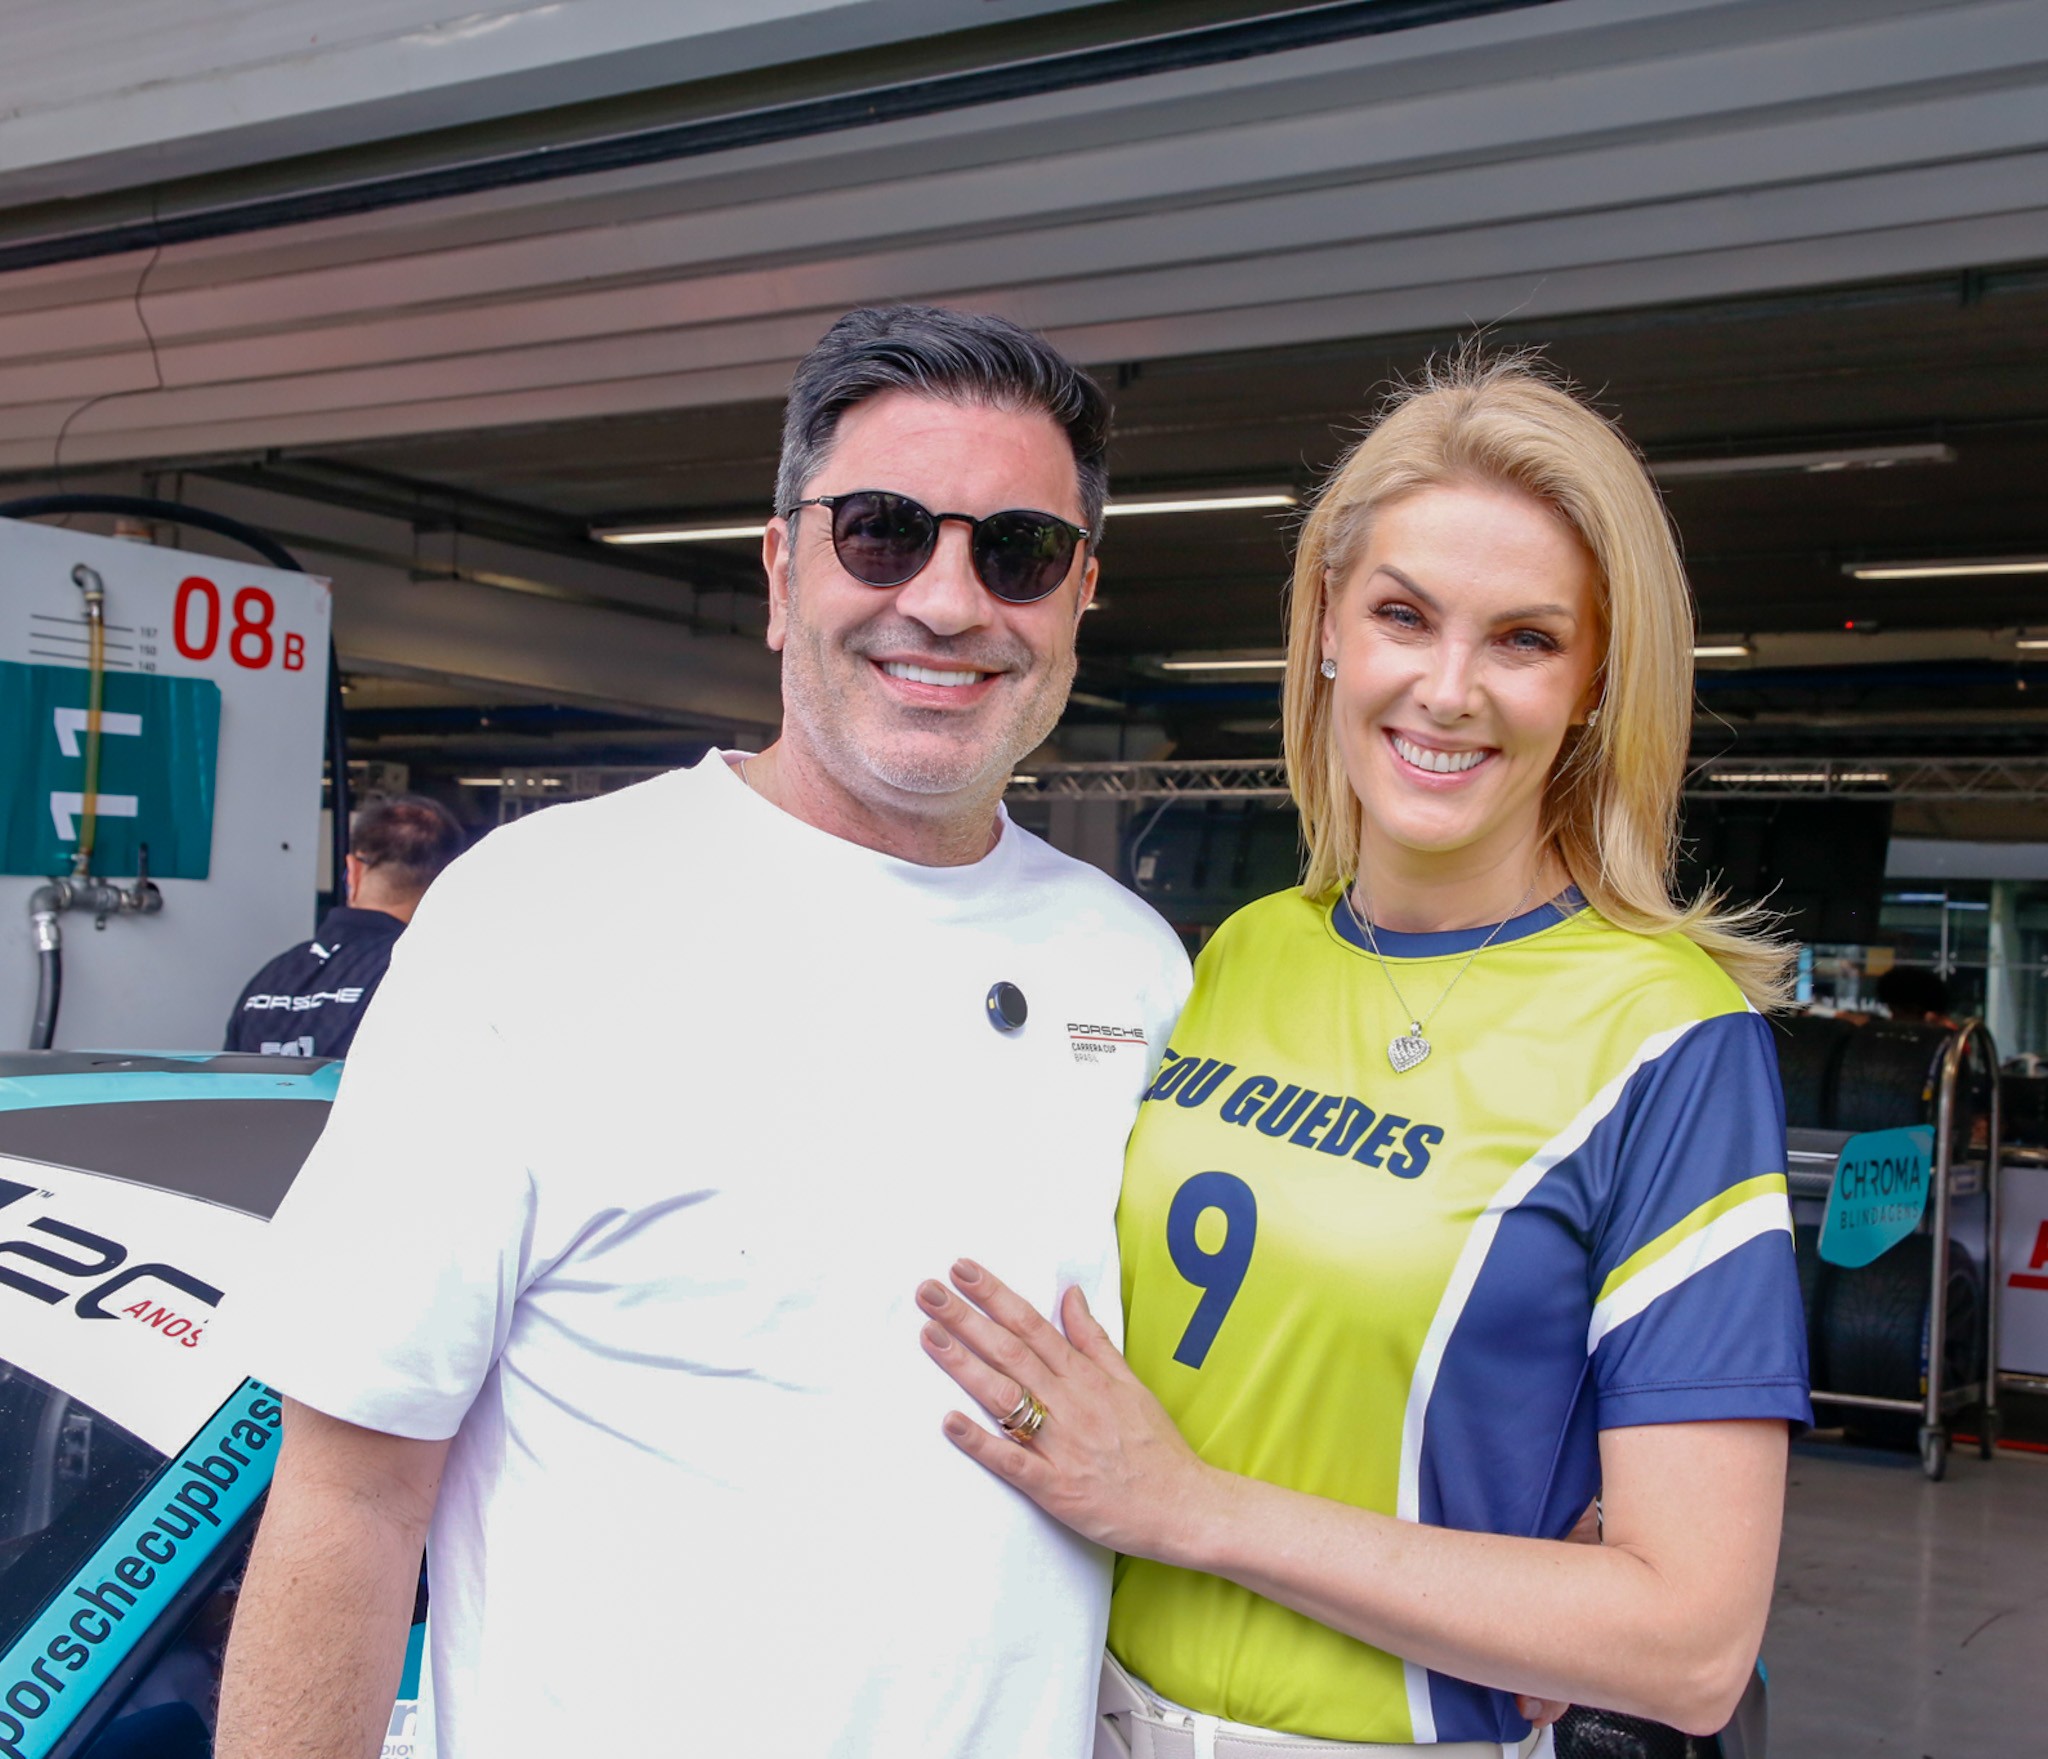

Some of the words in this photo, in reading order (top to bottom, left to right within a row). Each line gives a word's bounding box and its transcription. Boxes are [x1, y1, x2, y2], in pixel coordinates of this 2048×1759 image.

[244, 987, 364, 1012] PORSCHE
[1066, 1023, 1145, 1039] PORSCHE
[1071, 1042, 1103, 1053] CARRERA
[1103, 1044, 1117, 1054] CUP
[1220, 1075, 1445, 1179] GUEDES
[1841, 1156, 1921, 1201] CHROMA
[1166, 1171, 1258, 1370] 9
[122, 1300, 204, 1348] ANOS
